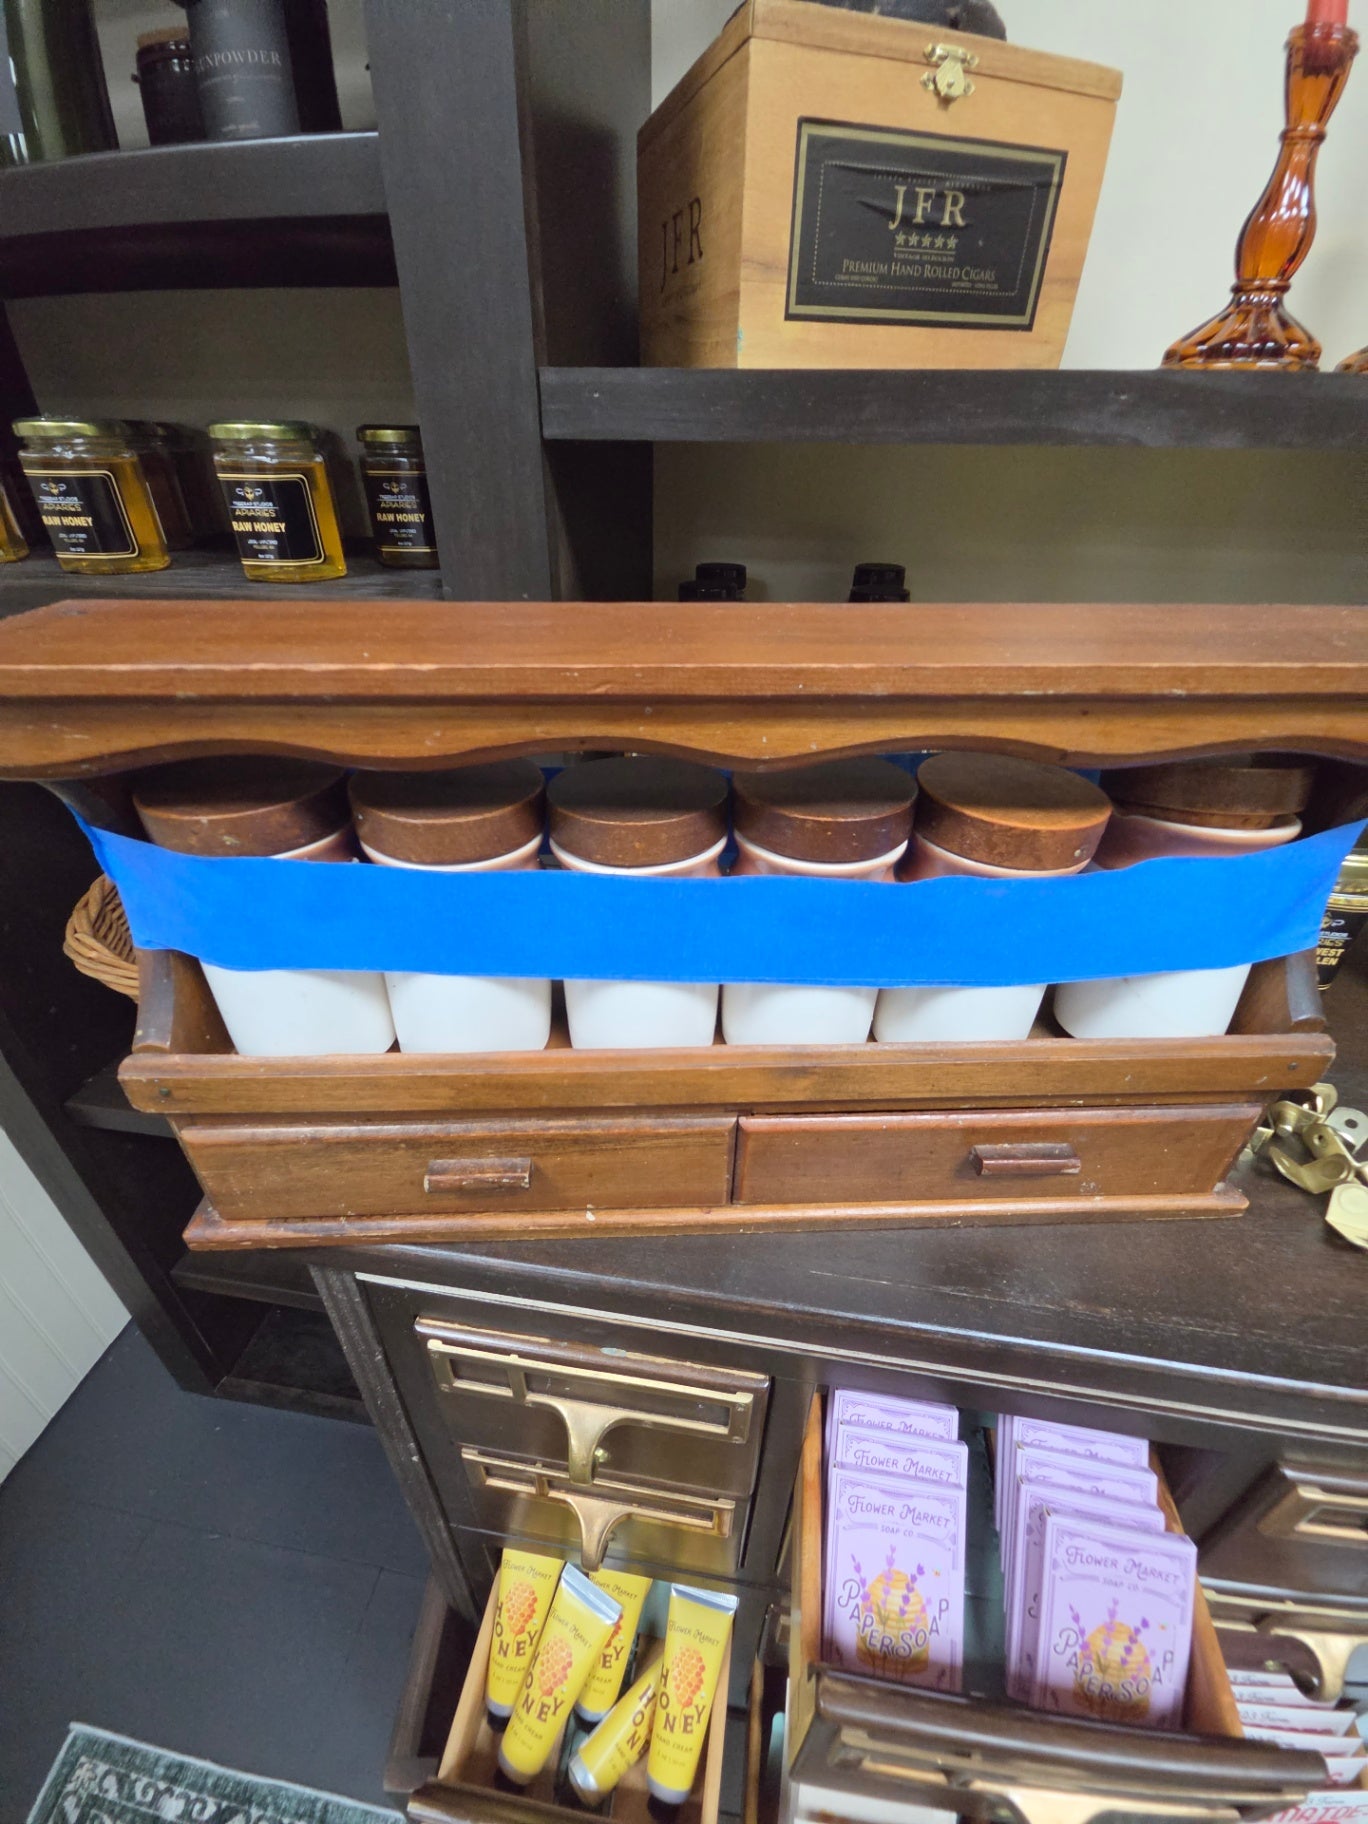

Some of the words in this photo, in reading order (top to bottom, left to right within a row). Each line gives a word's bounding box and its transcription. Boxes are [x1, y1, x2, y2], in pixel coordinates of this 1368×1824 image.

[889, 185, 967, 230] JFR
[659, 196, 703, 293] JFR
[842, 258, 888, 274] PREMIUM
[890, 261, 922, 277] HAND
[923, 264, 960, 280] ROLLED
[961, 266, 996, 281] CIGARS
[61, 516, 93, 527] HONEY
[232, 521, 252, 532] RAW
[253, 522, 286, 533] HONEY
[376, 513, 395, 522] RAW
[396, 513, 425, 523] HONEY
[853, 1449, 898, 1467] FLOWER
[903, 1457, 952, 1483] MARKET
[847, 1494, 895, 1514] FLOWER
[899, 1504, 950, 1528] MARKET
[881, 1524, 900, 1535] SOAP
[503, 1560, 525, 1571] FLOWER
[526, 1565, 552, 1580] MARKET
[1066, 1545, 1118, 1569] FLOWER
[1123, 1558, 1181, 1584] MARKET
[669, 1619, 692, 1636] FLOWER
[692, 1630, 720, 1647] MARKET
[838, 1579, 893, 1657] PAPER
[895, 1598, 950, 1660] SOAP
[659, 1663, 706, 1734] HONEY
